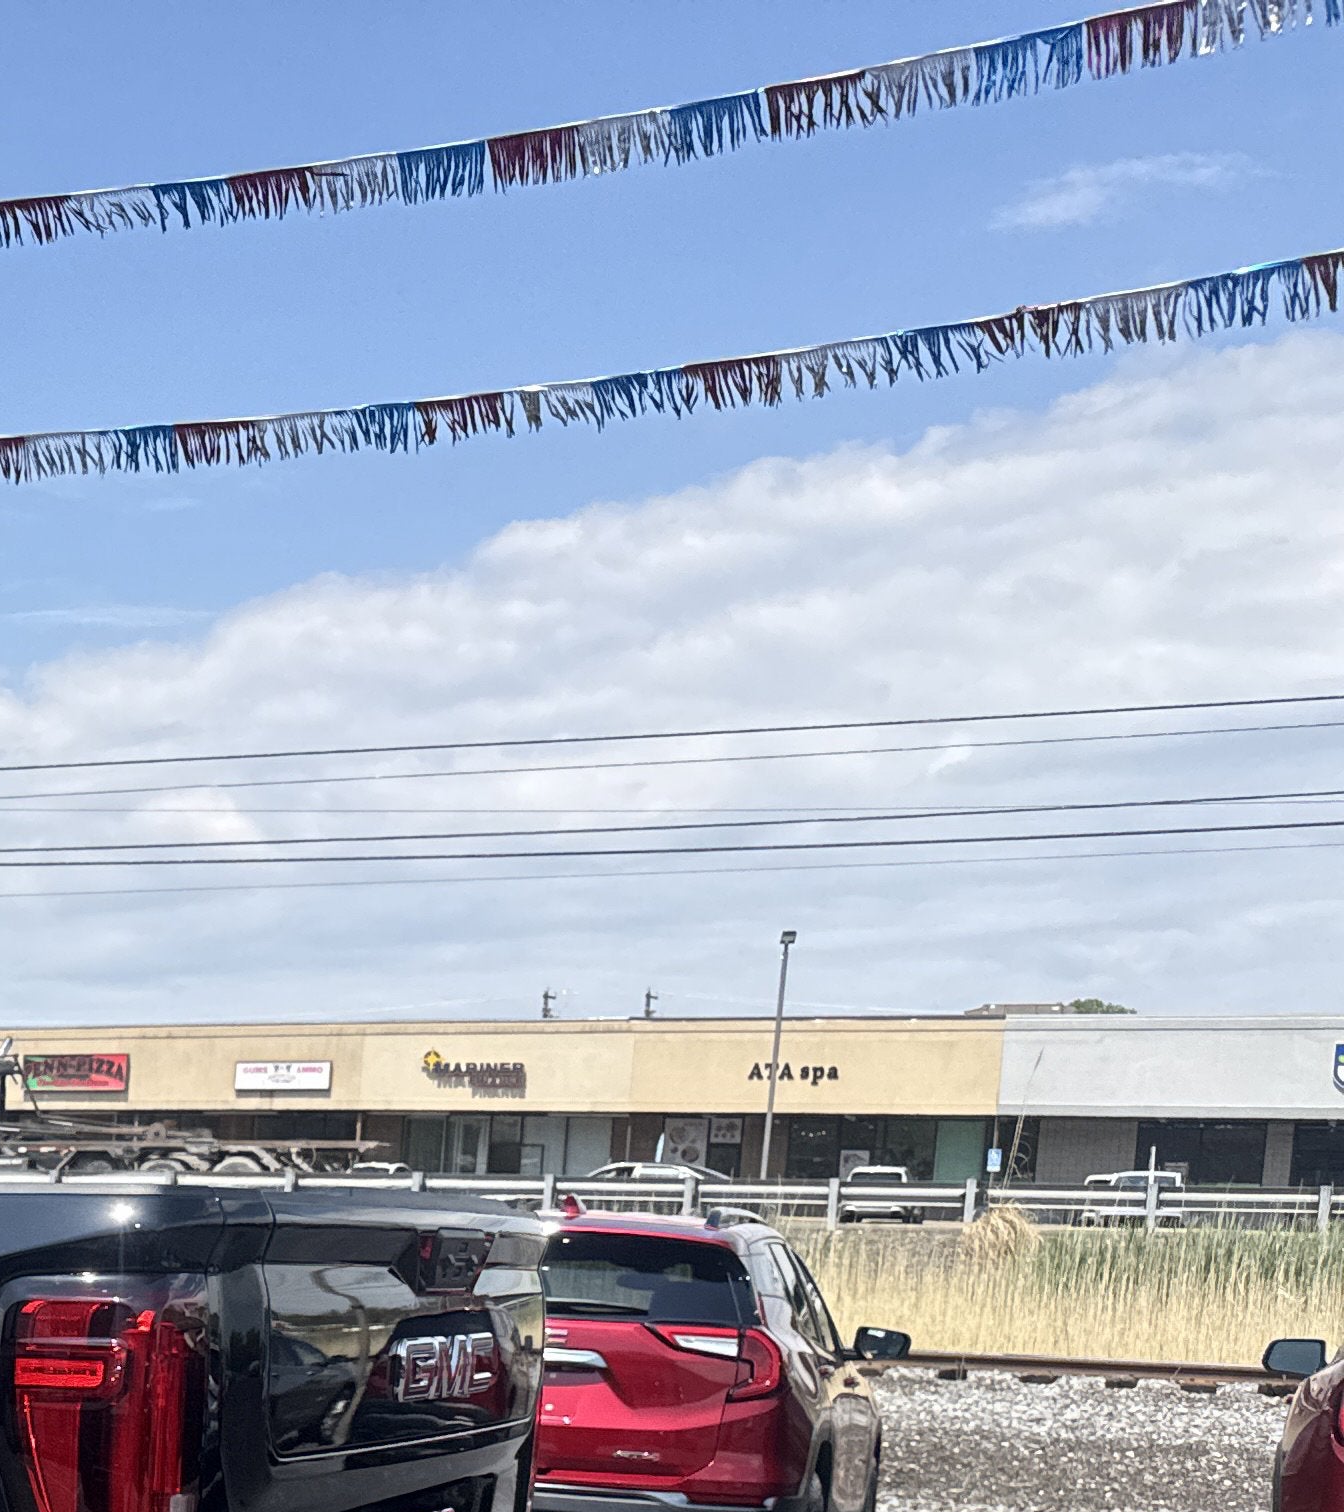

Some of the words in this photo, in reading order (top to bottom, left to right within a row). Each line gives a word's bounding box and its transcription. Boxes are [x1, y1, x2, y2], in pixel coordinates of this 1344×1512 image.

[748, 1062, 794, 1081] ATA
[800, 1065, 839, 1087] spa
[390, 1332, 494, 1402] GMC
